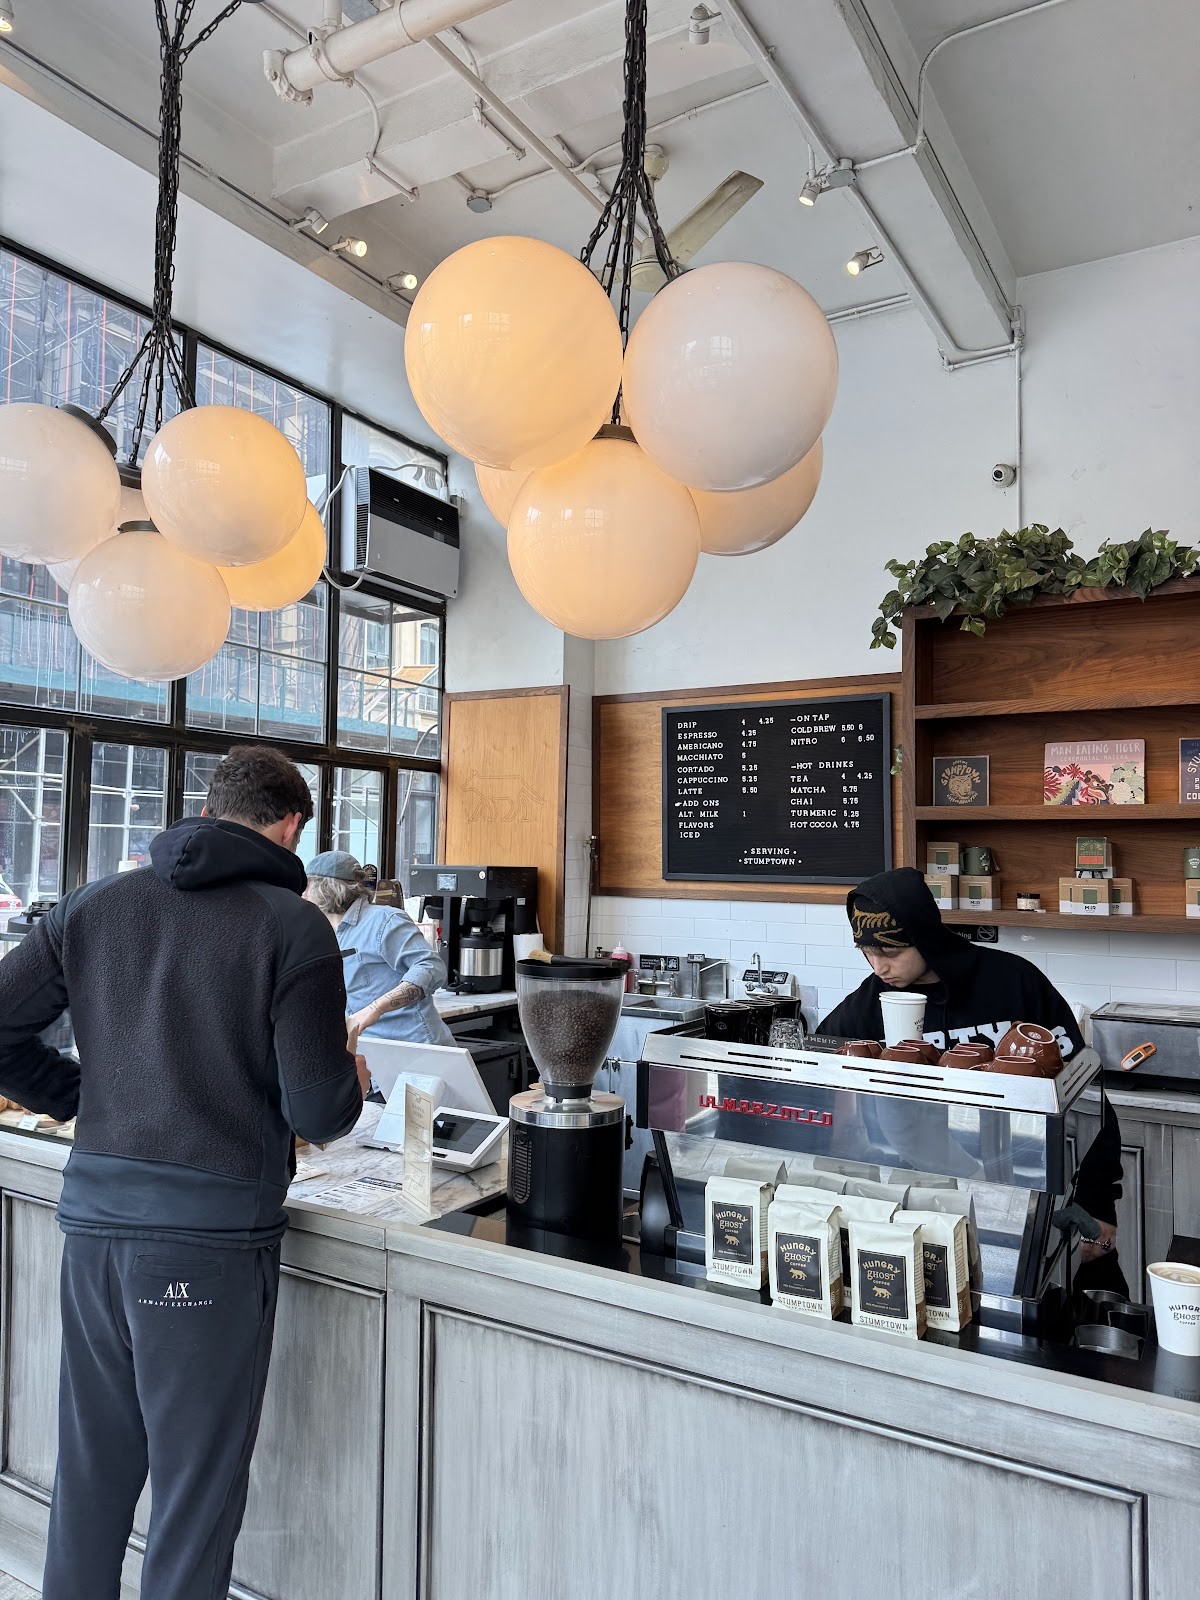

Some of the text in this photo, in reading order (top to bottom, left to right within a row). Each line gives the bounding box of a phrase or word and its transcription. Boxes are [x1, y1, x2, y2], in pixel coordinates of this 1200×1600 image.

[811, 713, 830, 722] TAP
[677, 716, 774, 731] DRIP 4 4.25
[858, 723, 864, 731] 6
[677, 729, 757, 740] ESPRESSO 4.25
[790, 733, 875, 746] NITRO 6 6.50
[676, 740, 757, 751] AMERICANO 4.75
[1051, 745, 1072, 756] MAN
[1076, 743, 1109, 755] EATING
[676, 752, 724, 762] MACCHIATO
[676, 764, 758, 774] CORTADO 5.25
[818, 760, 854, 769] DRINKS
[676, 775, 758, 785] CAPPUCCINO 5.25
[790, 771, 873, 783] TEA 4 4.25
[677, 787, 703, 795] LATTE
[790, 786, 827, 794] MATCHA
[682, 799, 720, 807] ADD ONS
[790, 797, 859, 806] CHAI 5.75
[677, 810, 746, 818] ALT. MILK 1
[790, 809, 860, 818] TURMERIC 5.25
[678, 821, 714, 829] FLAVORS
[843, 820, 860, 829] 4.75
[679, 831, 701, 839] ICED
[750, 847, 790, 855] SERVING
[743, 857, 796, 866] STUMPTOWN
[698, 1094, 833, 1127] LA MARZOCCO
[923, 1250, 943, 1264] GRY
[712, 1261, 753, 1275] STUMPTOWN
[137, 1298, 214, 1307] ARMANI EXCHANGE
[777, 1296, 823, 1311] STUMPTOWN
[859, 1315, 909, 1331] STUMPTOWN
